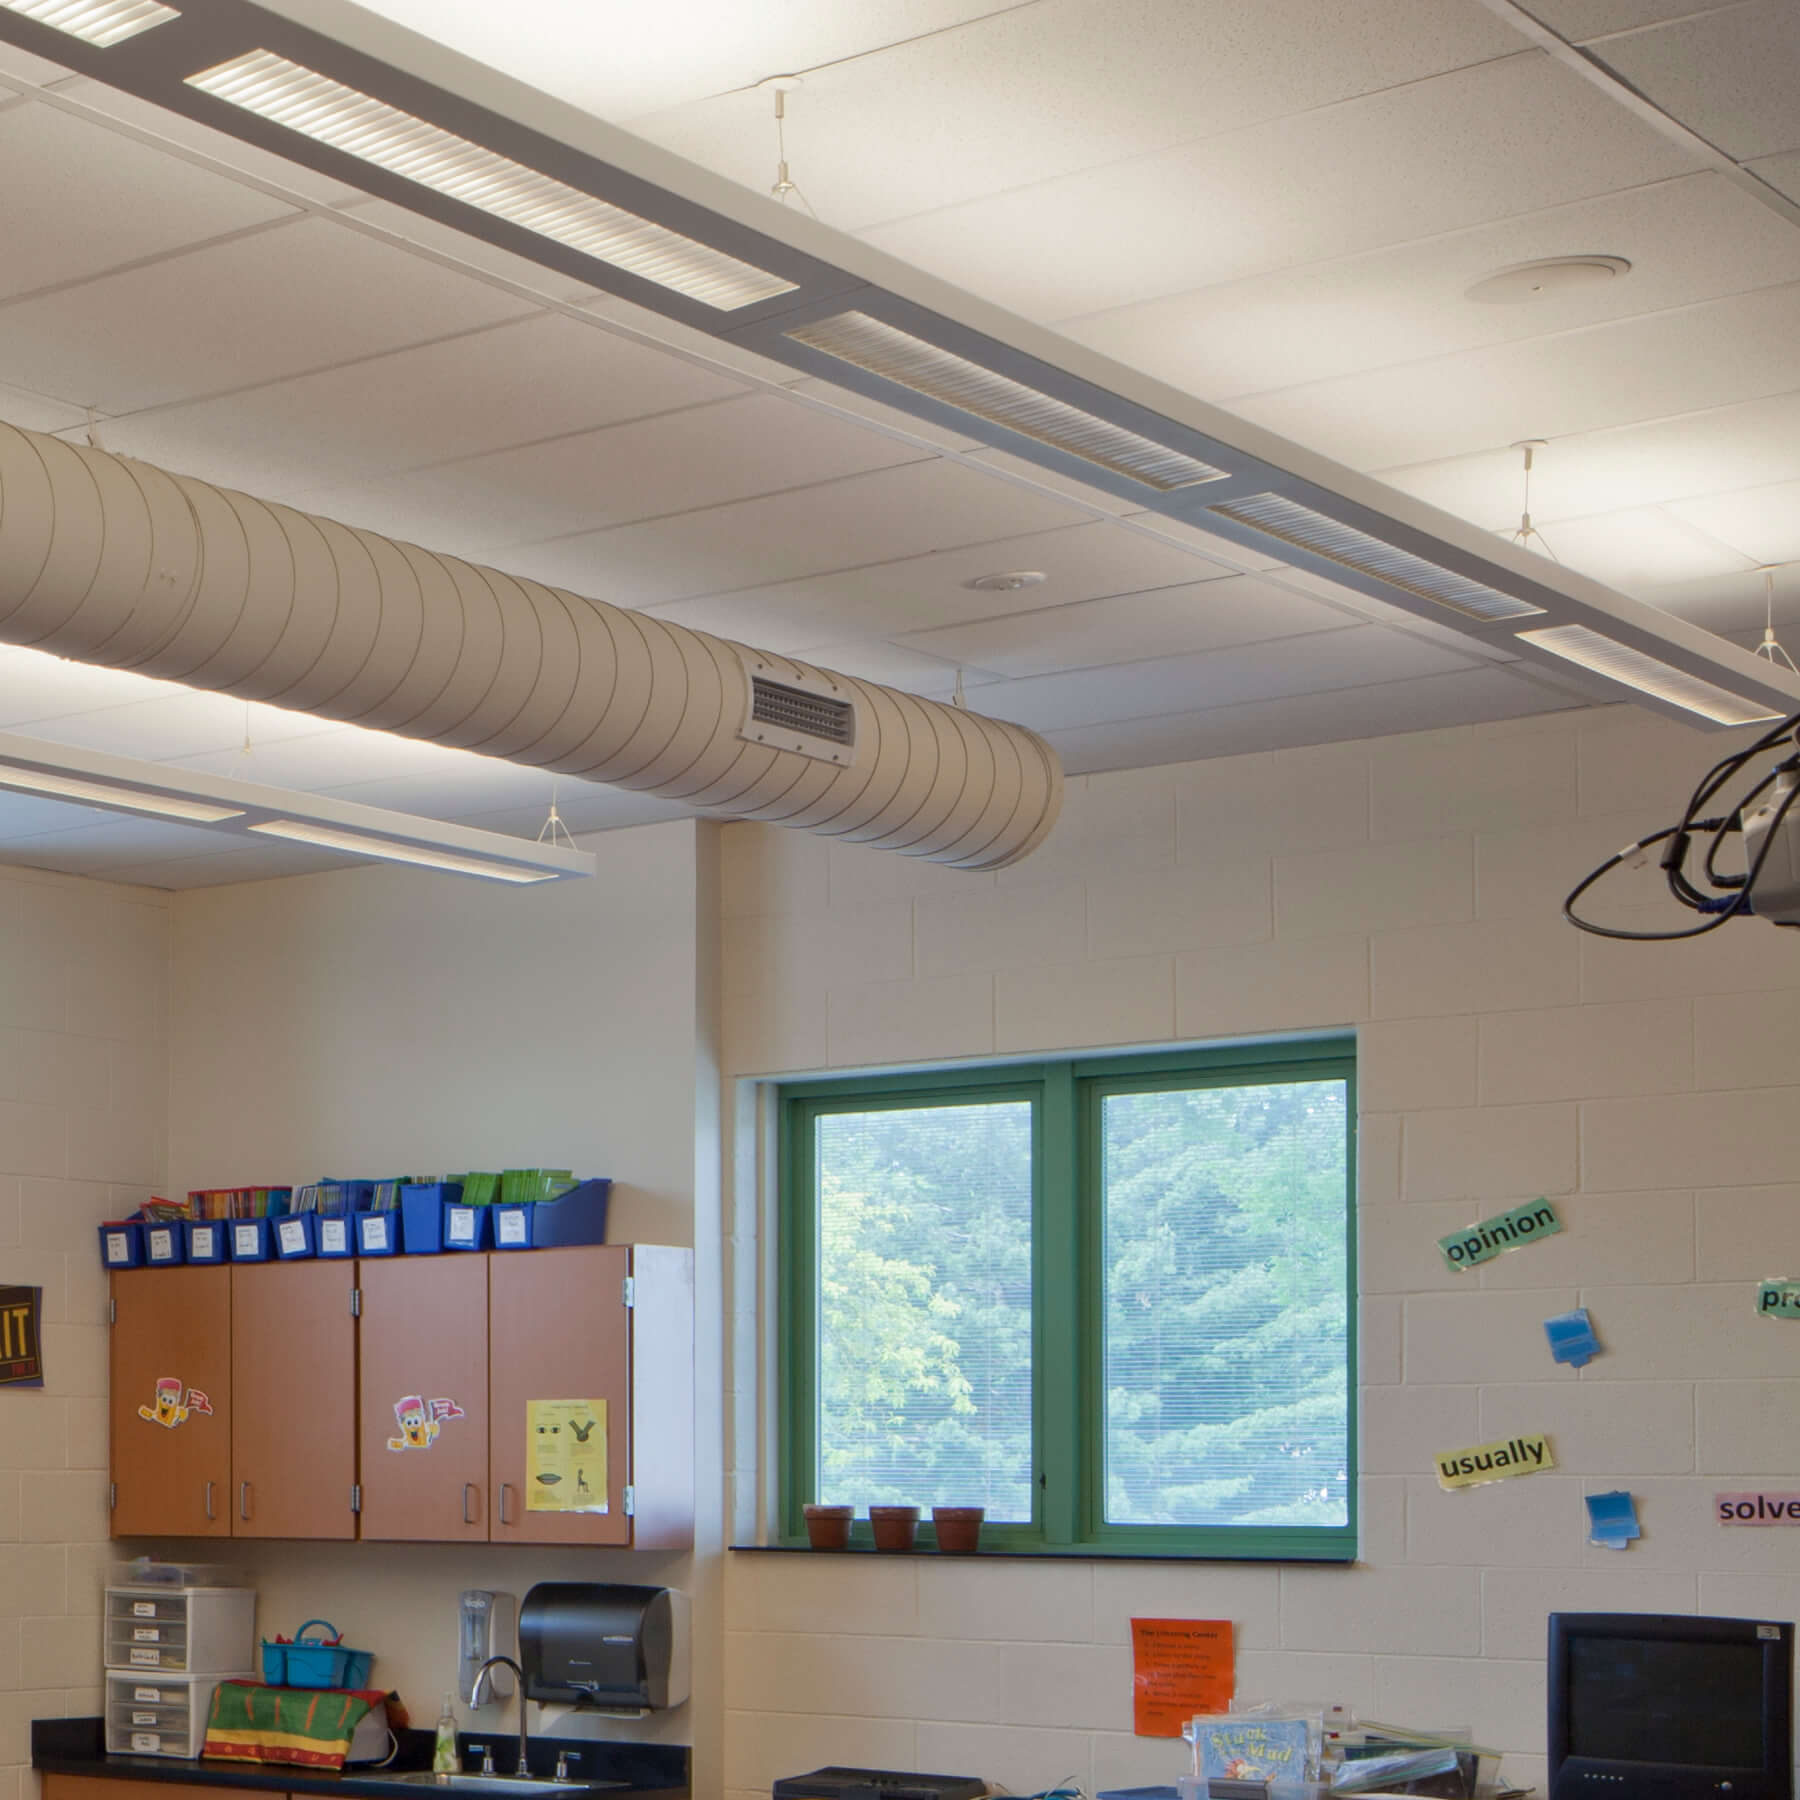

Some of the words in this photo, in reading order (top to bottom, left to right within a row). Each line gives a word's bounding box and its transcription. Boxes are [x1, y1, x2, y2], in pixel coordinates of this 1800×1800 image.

[1446, 1205, 1555, 1264] opinion
[1441, 1439, 1545, 1478] usually
[1719, 1496, 1800, 1519] solve
[1248, 1744, 1293, 1763] Mud
